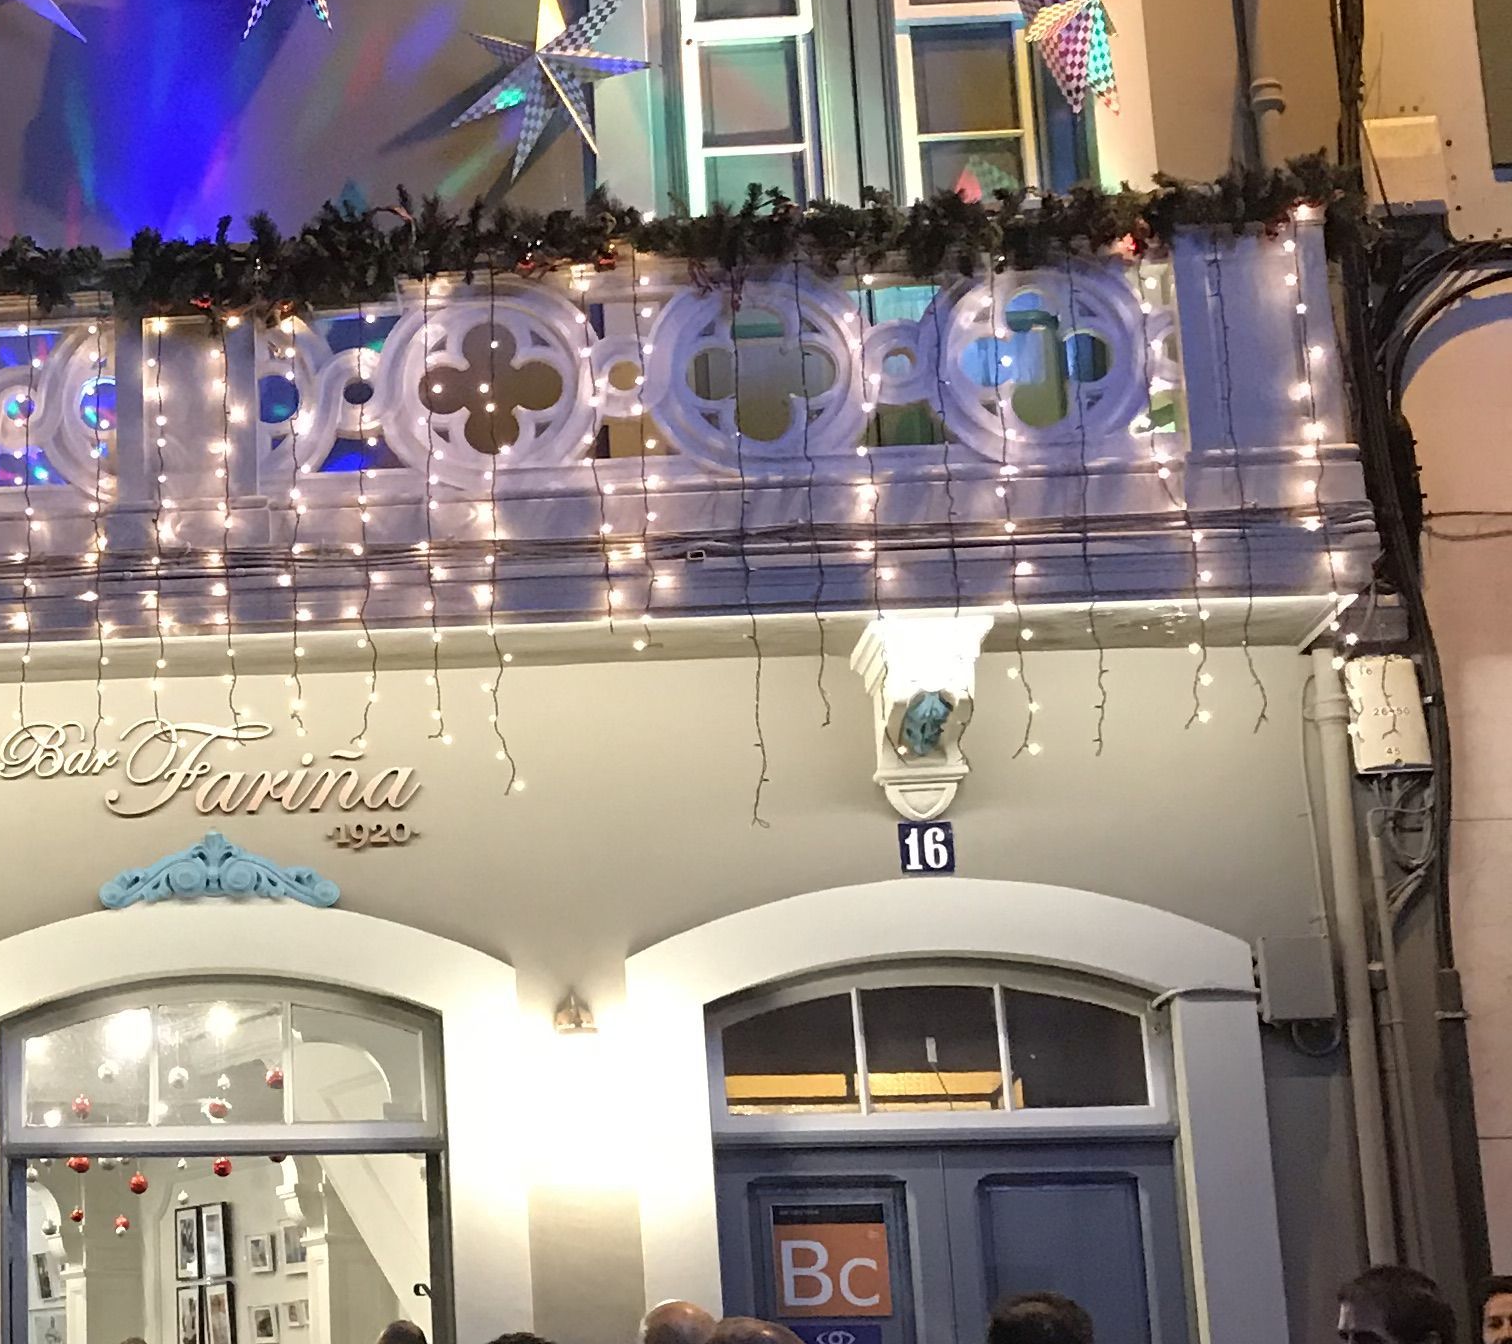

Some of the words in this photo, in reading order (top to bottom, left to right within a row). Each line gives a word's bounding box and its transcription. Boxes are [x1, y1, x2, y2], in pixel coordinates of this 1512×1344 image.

[104, 716, 423, 818] Fariña
[904, 826, 949, 870] 16
[780, 1238, 881, 1307] Bc
